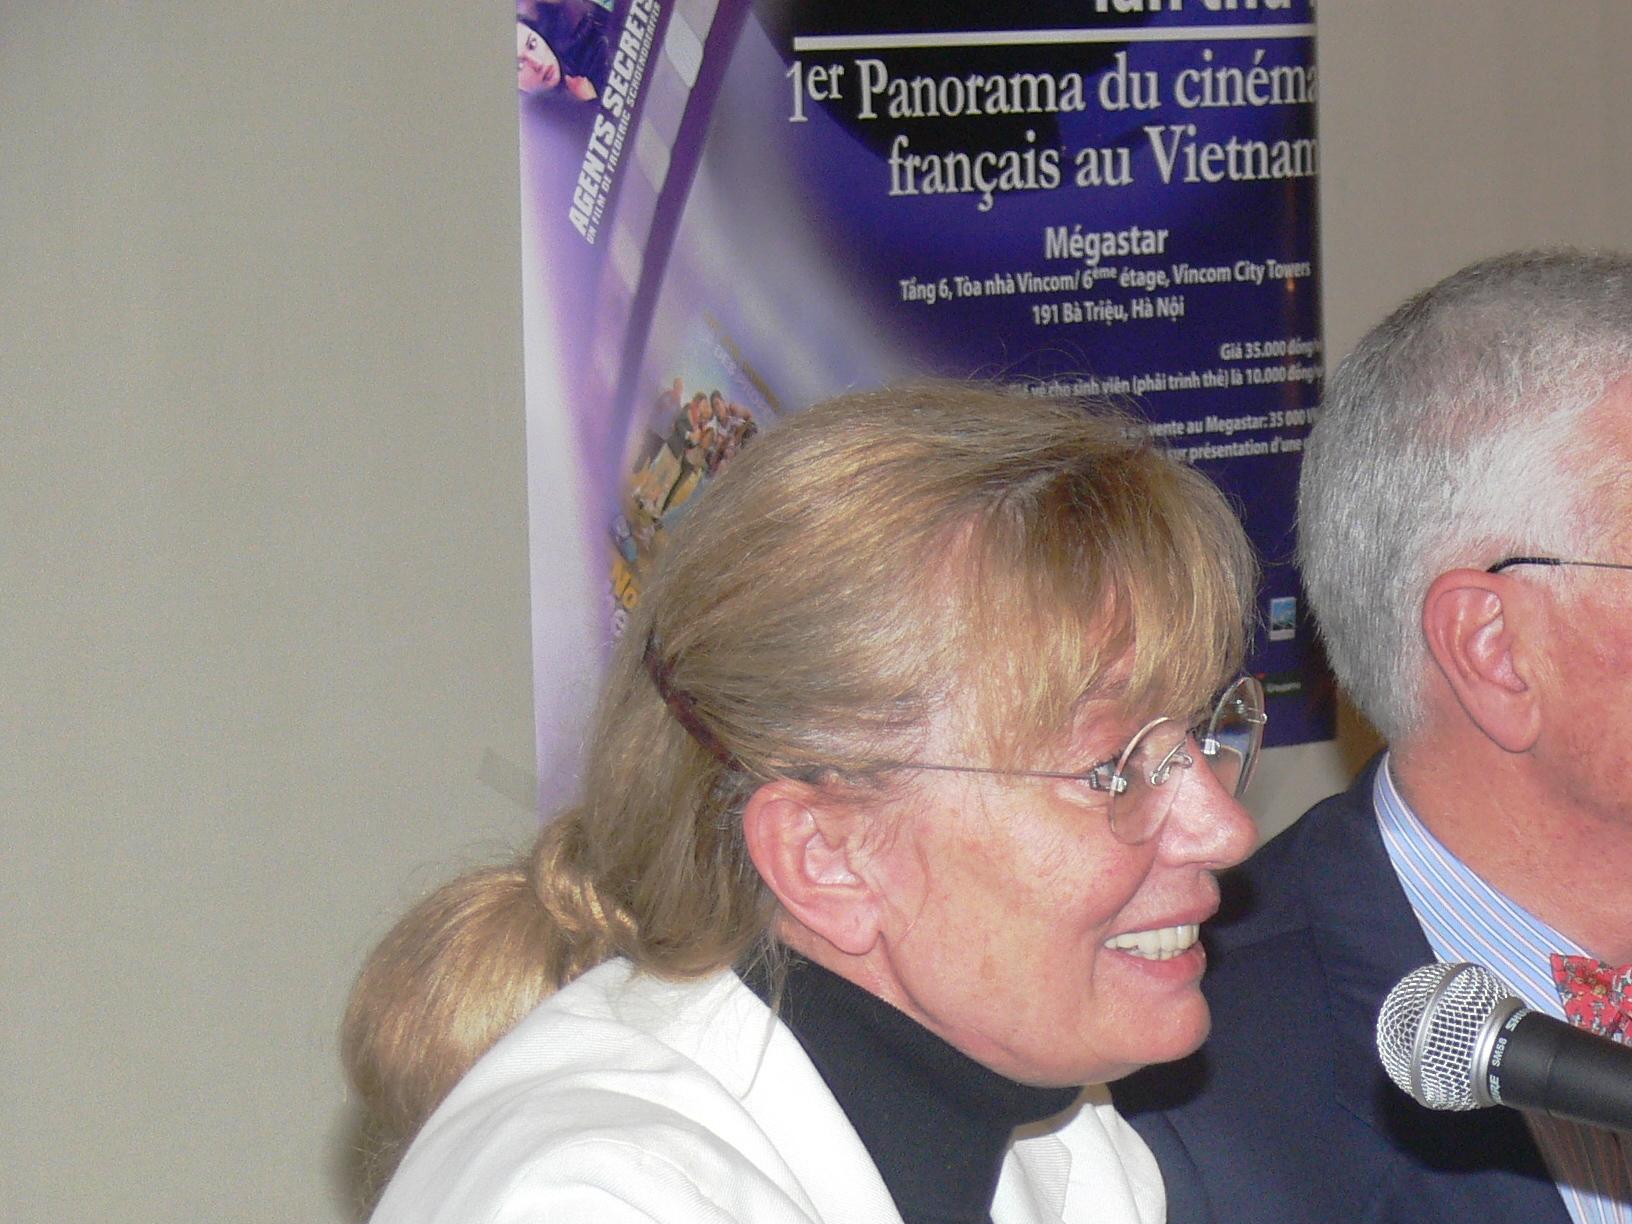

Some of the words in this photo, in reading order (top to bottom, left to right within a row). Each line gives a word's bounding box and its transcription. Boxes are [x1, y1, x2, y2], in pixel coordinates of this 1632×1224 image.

[786, 60, 845, 123] 1er
[854, 58, 1086, 120] Panorama
[1097, 50, 1162, 111] du
[569, 112, 617, 237] AGENTS
[888, 129, 1061, 212] français
[1074, 146, 1134, 188] au
[1143, 123, 1318, 185] Vietnam
[591, 197, 608, 226] FILM
[601, 178, 613, 197] DE
[1044, 224, 1169, 268] Mégastar
[938, 277, 953, 300] 6,
[984, 272, 1015, 295] nhà
[1016, 270, 1080, 294] Vincom/
[1119, 266, 1171, 292] étage,
[1171, 262, 1232, 285] Vincom
[1233, 259, 1266, 286] City
[1265, 258, 1312, 279] Towers
[1032, 304, 1060, 325] 191
[1061, 300, 1083, 323] Bà
[1131, 298, 1154, 319] Hà
[1156, 294, 1185, 322] Nội
[1244, 339, 1287, 360] 35.000
[1245, 366, 1287, 385] 10.000
[1186, 420, 1204, 435] au
[1268, 411, 1284, 428] 35
[1188, 438, 1269, 464] présentation
[1491, 1037, 1508, 1068] SM58
